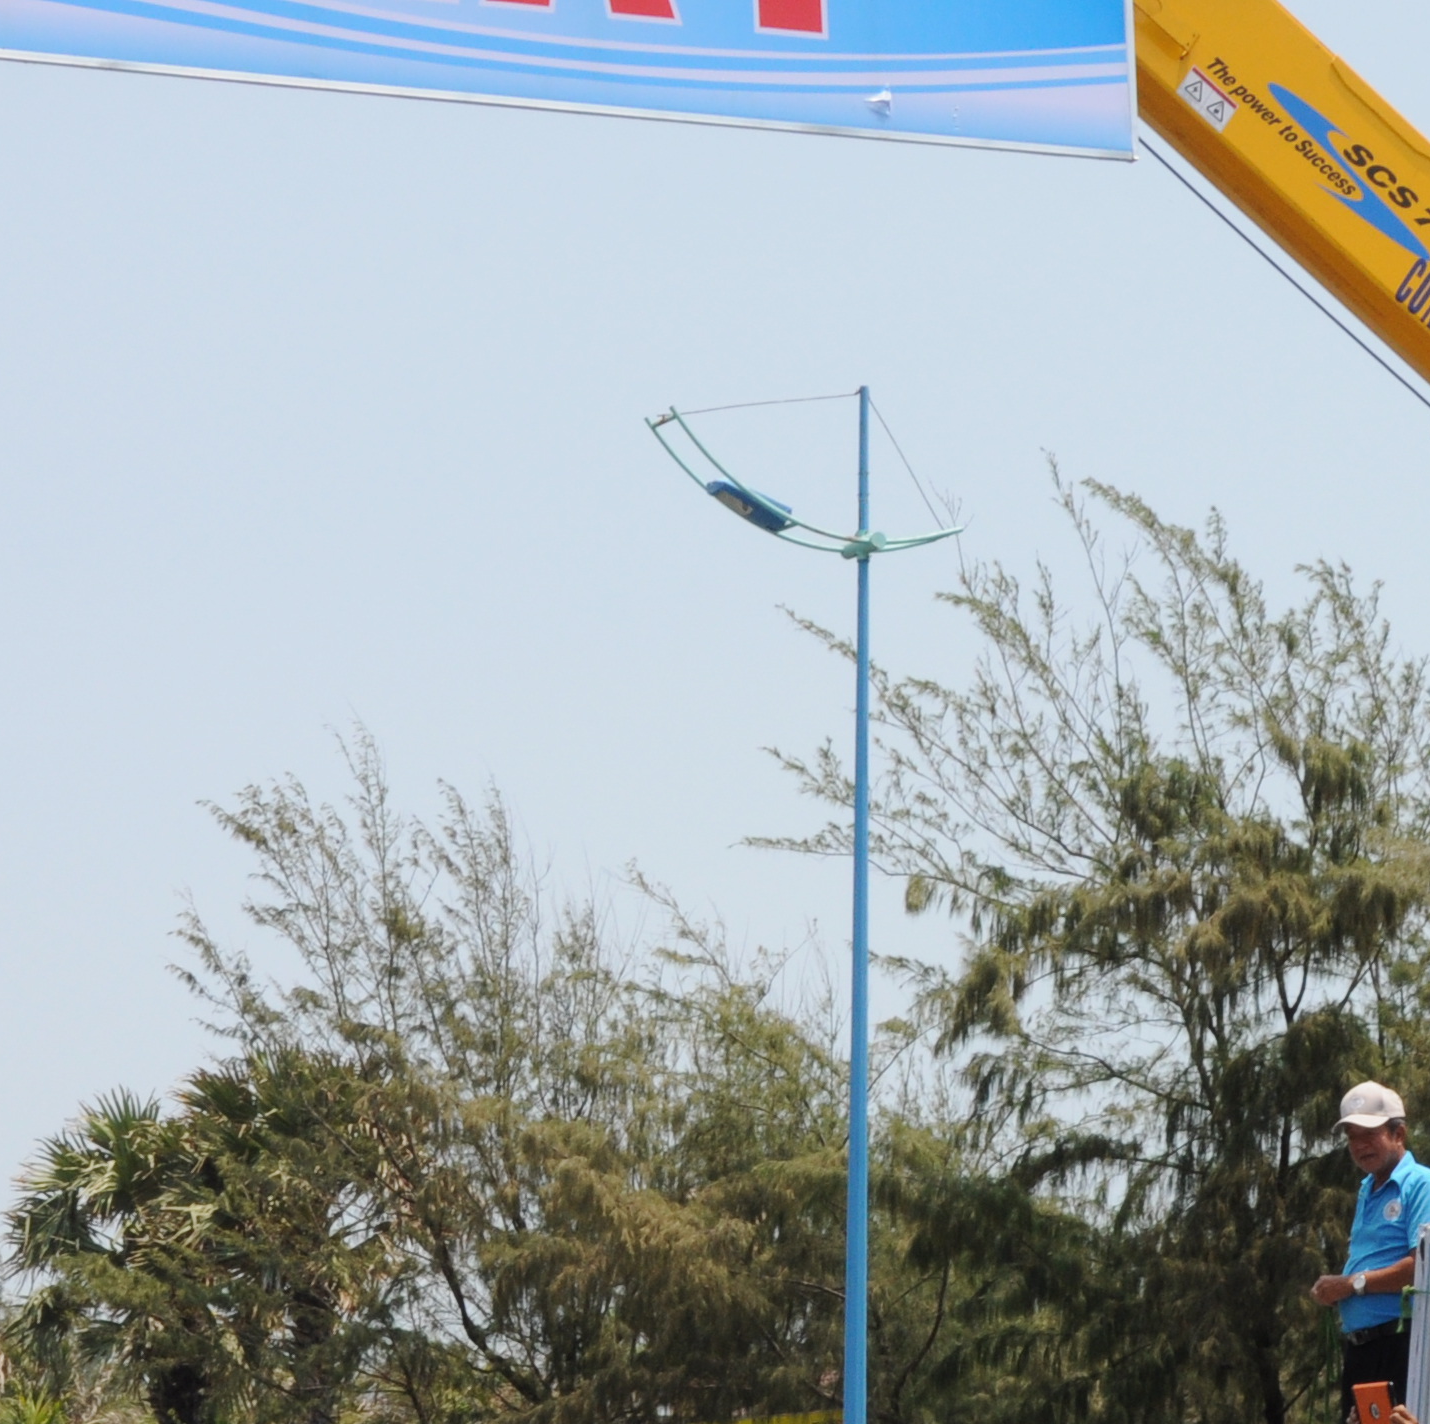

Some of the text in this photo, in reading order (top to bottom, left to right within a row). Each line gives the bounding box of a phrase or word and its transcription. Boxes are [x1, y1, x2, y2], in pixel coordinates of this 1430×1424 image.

[1207, 57, 1357, 197] The power to Success
[1342, 143, 1419, 210] SCS
